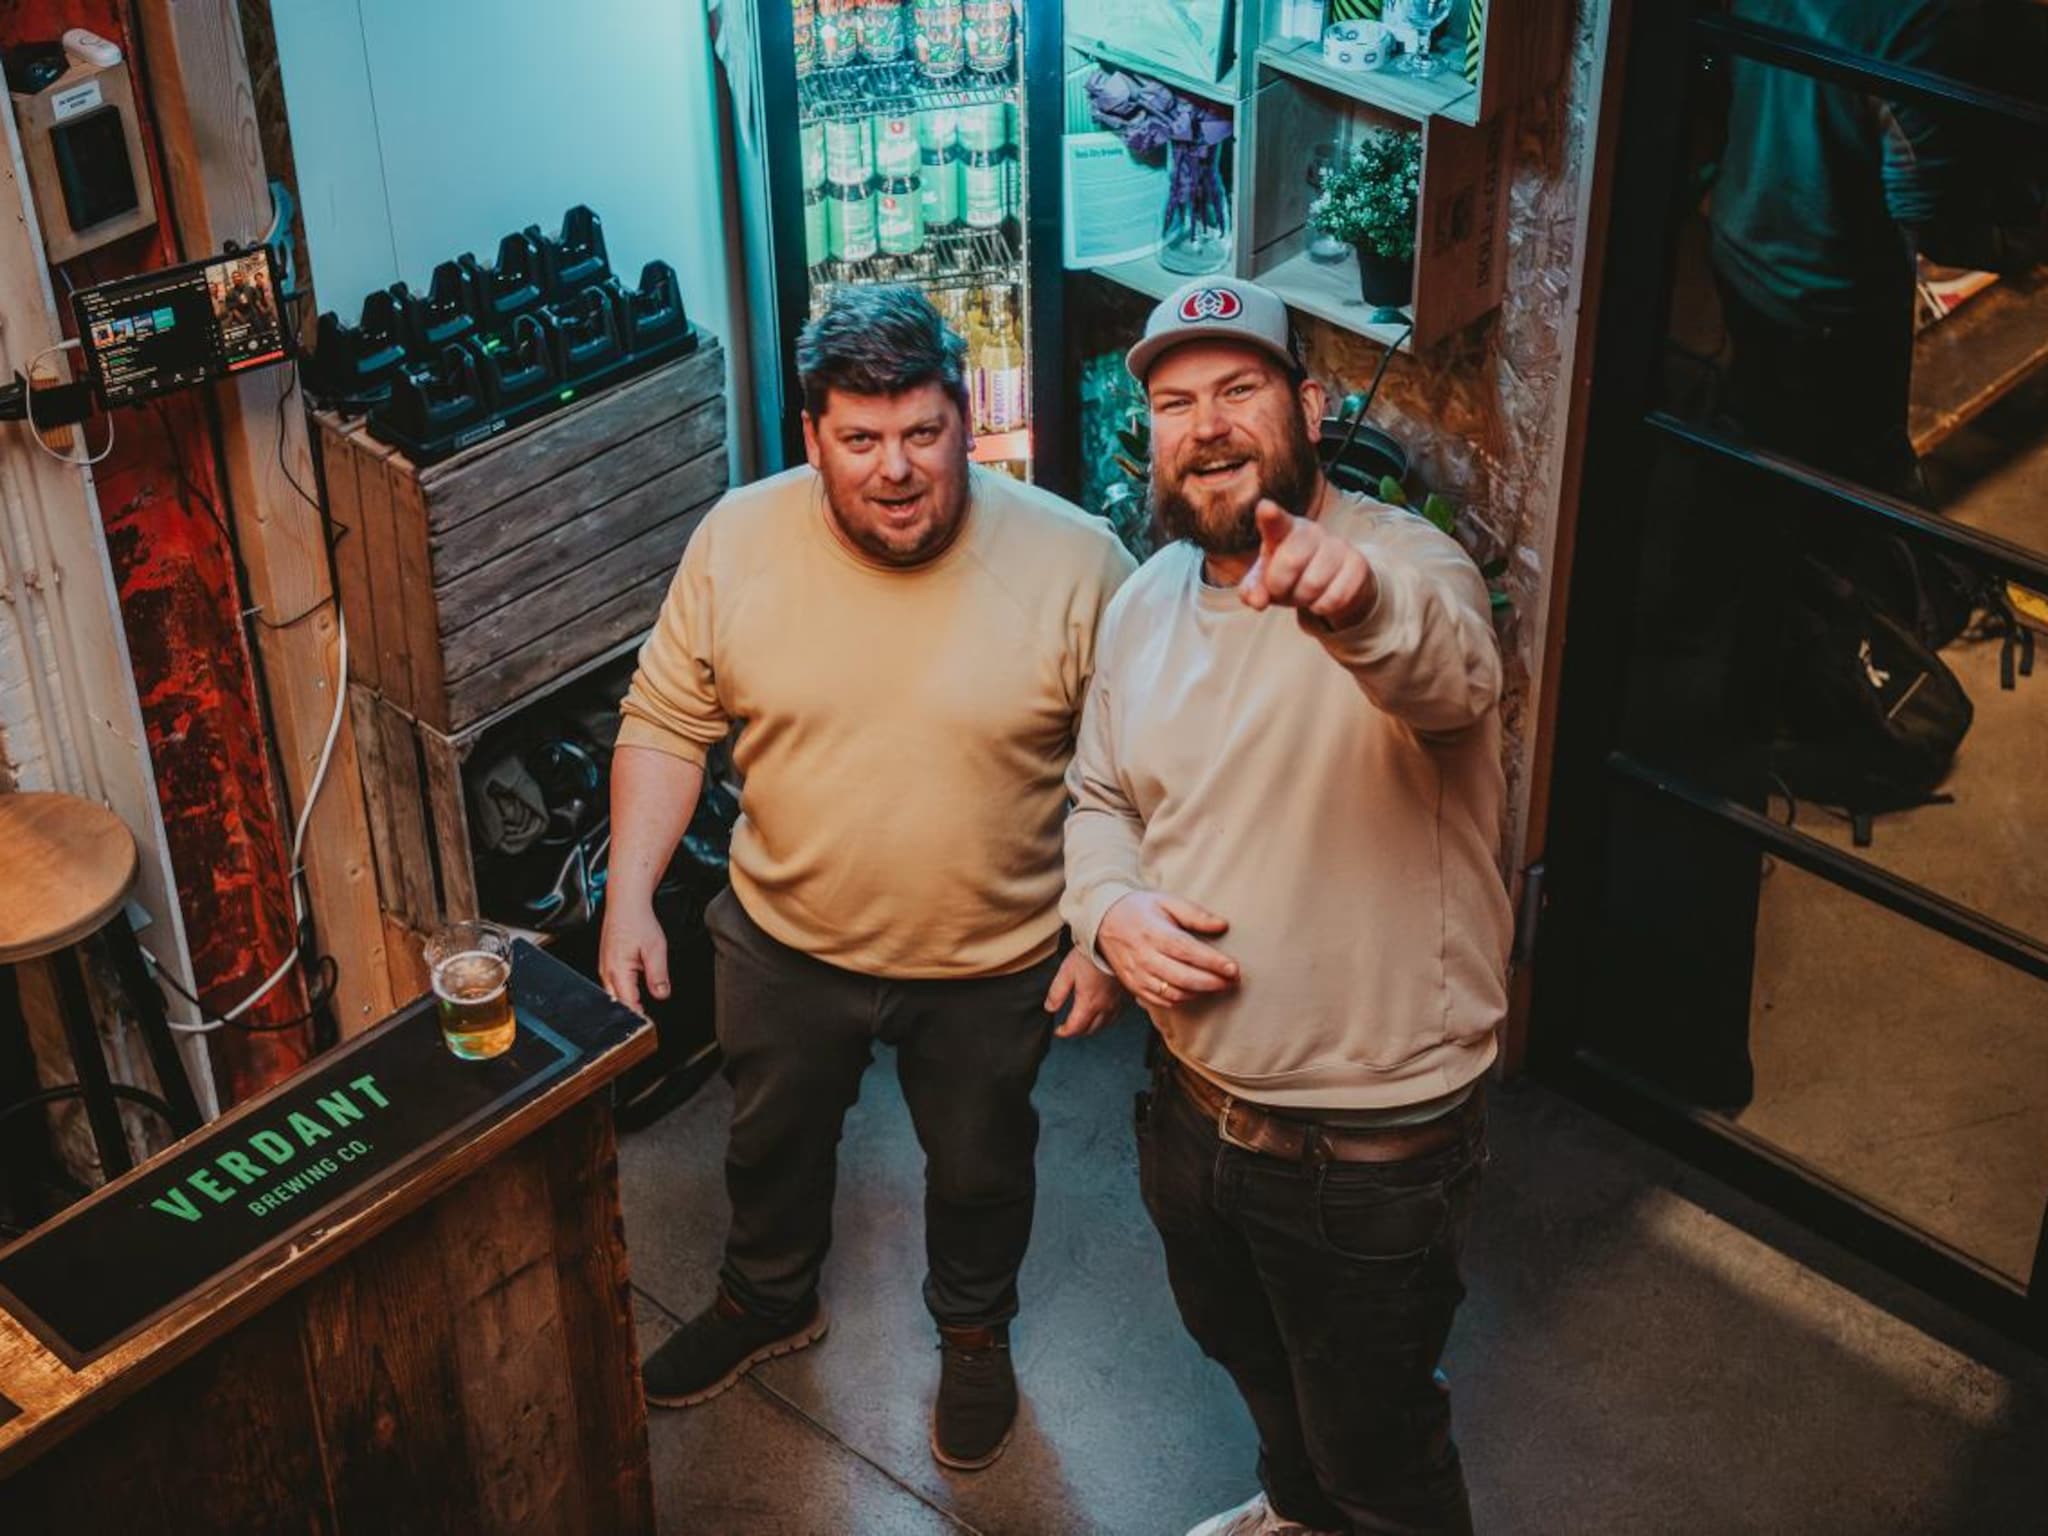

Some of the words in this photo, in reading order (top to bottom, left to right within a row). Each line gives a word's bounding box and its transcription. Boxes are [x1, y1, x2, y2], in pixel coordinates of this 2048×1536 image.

[152, 1075, 387, 1222] VERDANT
[248, 1158, 338, 1217] BREWING
[337, 1140, 374, 1162] CO.
